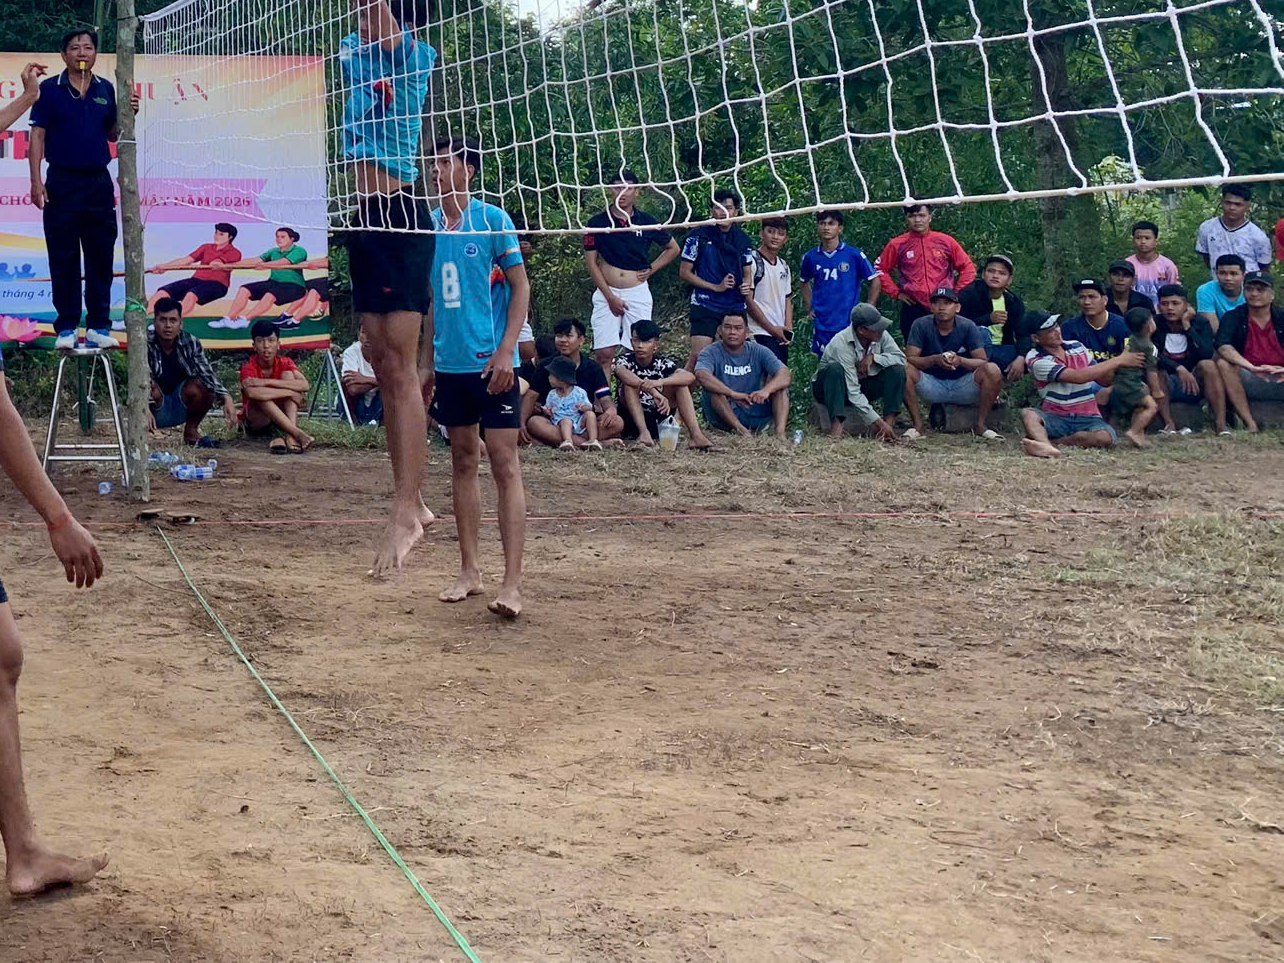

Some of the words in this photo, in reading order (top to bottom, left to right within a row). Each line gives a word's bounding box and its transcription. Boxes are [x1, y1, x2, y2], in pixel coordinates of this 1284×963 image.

[214, 196, 251, 207] 2026
[823, 268, 838, 281] 74
[2, 289, 35, 300] tháng
[37, 289, 45, 297] 4
